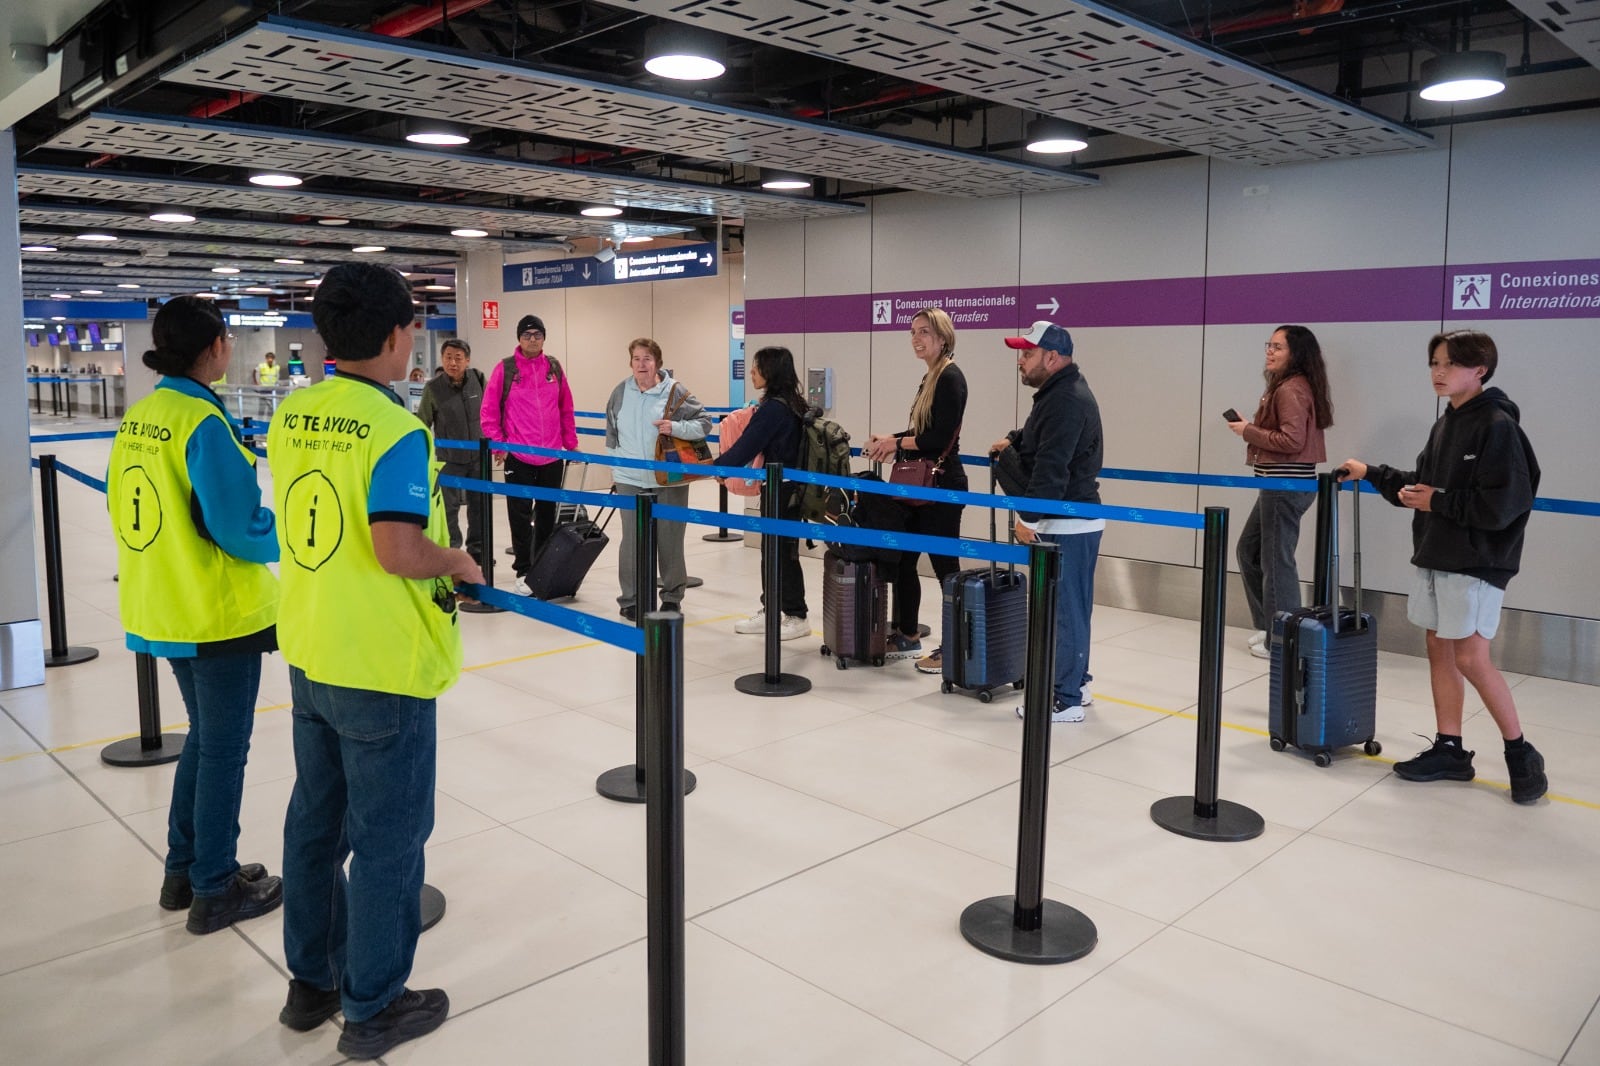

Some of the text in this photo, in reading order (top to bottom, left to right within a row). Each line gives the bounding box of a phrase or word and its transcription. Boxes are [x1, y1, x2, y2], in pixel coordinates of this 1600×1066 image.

[1500, 271, 1600, 288] Conexiones
[895, 294, 1016, 310] Conexiones Internacionales
[1500, 292, 1600, 310] Internationa
[949, 311, 989, 323] Transfers
[119, 421, 128, 433] O
[128, 421, 139, 436] TE
[283, 412, 371, 440] YO TE AYUDO
[331, 439, 353, 453] HELP
